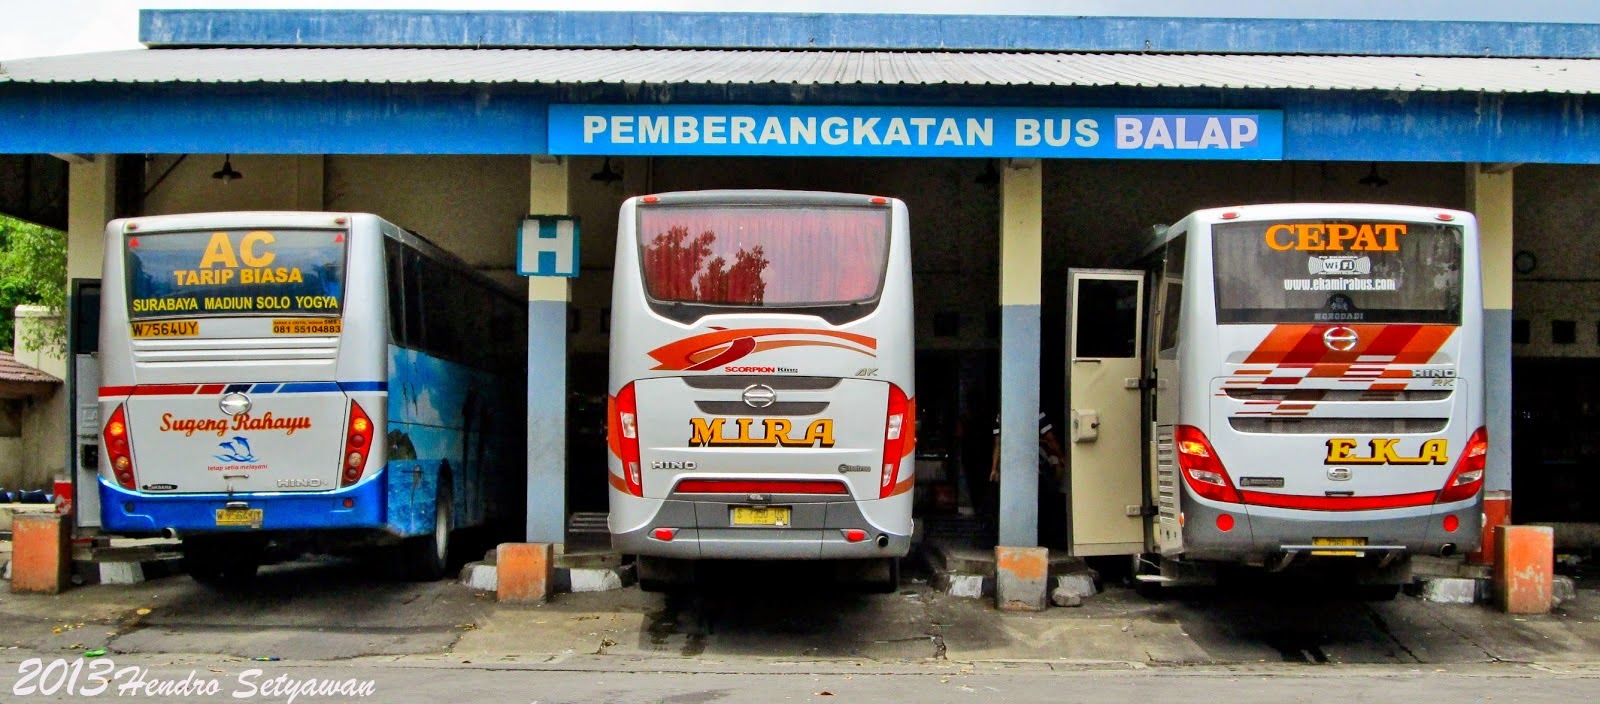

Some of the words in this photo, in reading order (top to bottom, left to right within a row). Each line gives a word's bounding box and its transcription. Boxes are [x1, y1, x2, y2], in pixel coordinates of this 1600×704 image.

[584, 115, 994, 146] PEMBERANGKATAN
[1014, 118, 1101, 148] BUS
[1116, 117, 1259, 150] BALAP
[1265, 224, 1407, 251] CEPAT
[200, 231, 275, 268] AC
[522, 219, 574, 274] H
[174, 269, 234, 286] TARIP
[240, 268, 303, 284] BIASA
[1284, 278, 1396, 291] www.ekamirabus.com
[133, 298, 198, 312] SURABAYA
[204, 297, 252, 310] MADIUN
[256, 297, 290, 309] SOLO
[295, 296, 338, 309] YOGYA
[131, 321, 198, 337] W7564UY
[273, 325, 291, 333] 081
[294, 325, 341, 333] 55104883
[855, 367, 879, 377] AK
[1412, 369, 1456, 378] HINO
[159, 412, 230, 437] Sugeng
[231, 411, 312, 437] Rahayu
[688, 417, 835, 448] MIRA
[1324, 438, 1449, 466] EKA
[651, 461, 697, 470] HINO
[276, 478, 321, 487] HINO
